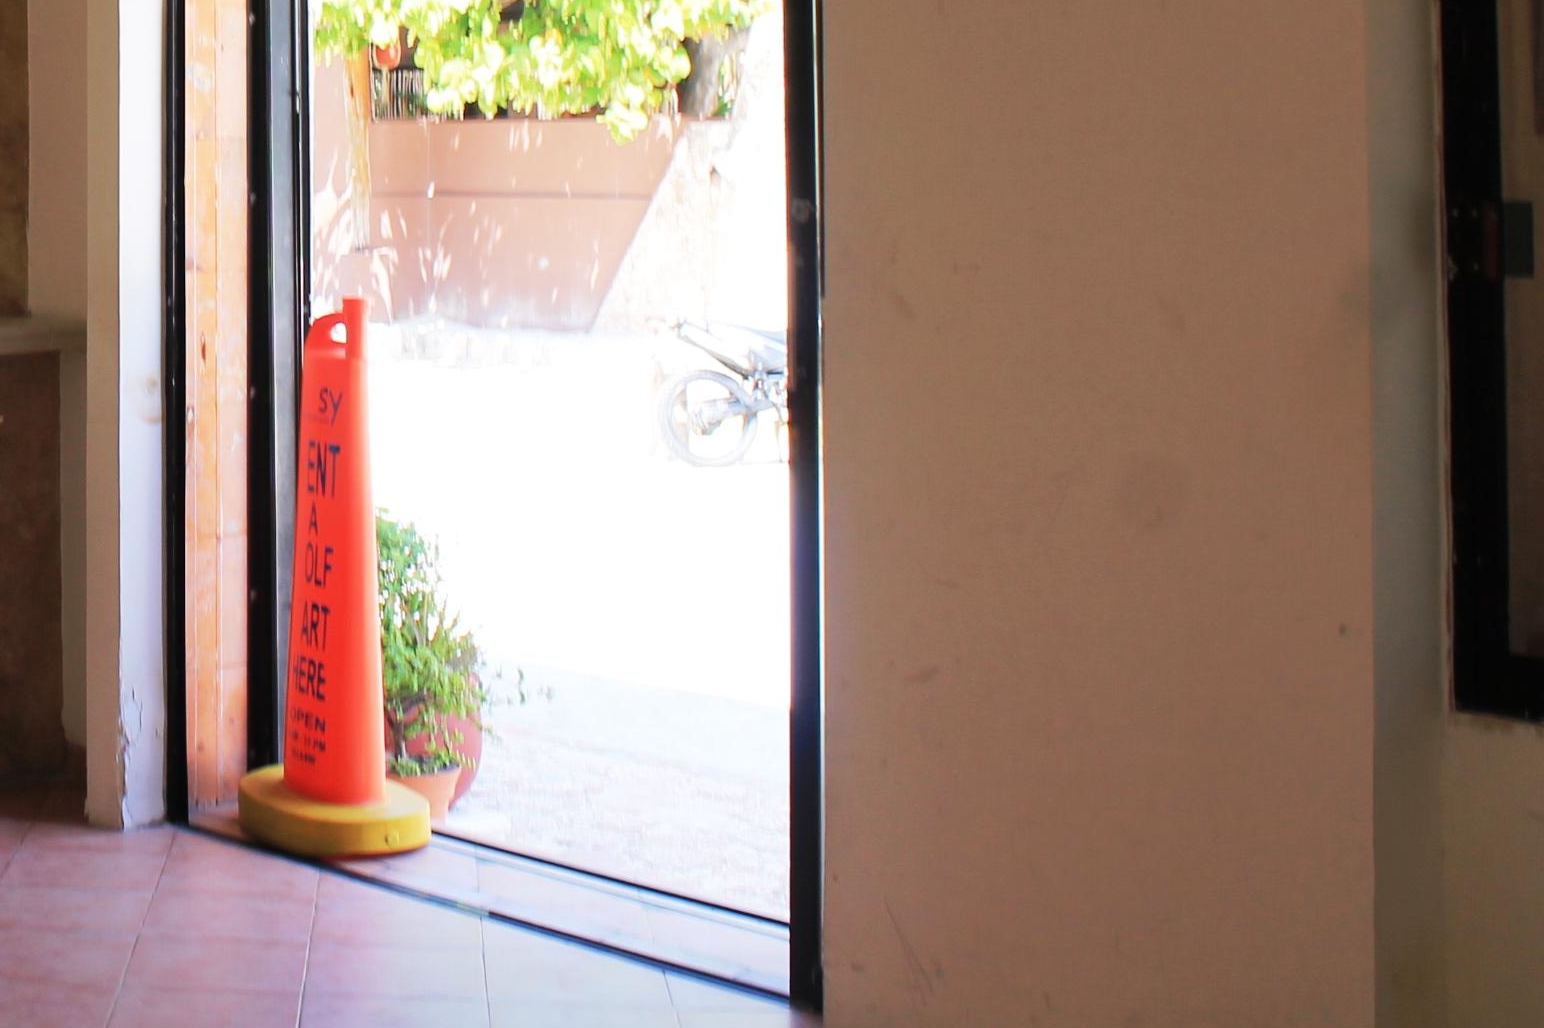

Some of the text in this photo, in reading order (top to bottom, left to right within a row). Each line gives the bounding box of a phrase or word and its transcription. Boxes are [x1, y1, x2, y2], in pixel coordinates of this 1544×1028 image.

[308, 503, 318, 536] A
[302, 600, 330, 651] ART
[293, 653, 326, 702] HERE
[290, 707, 326, 734] OPEN
